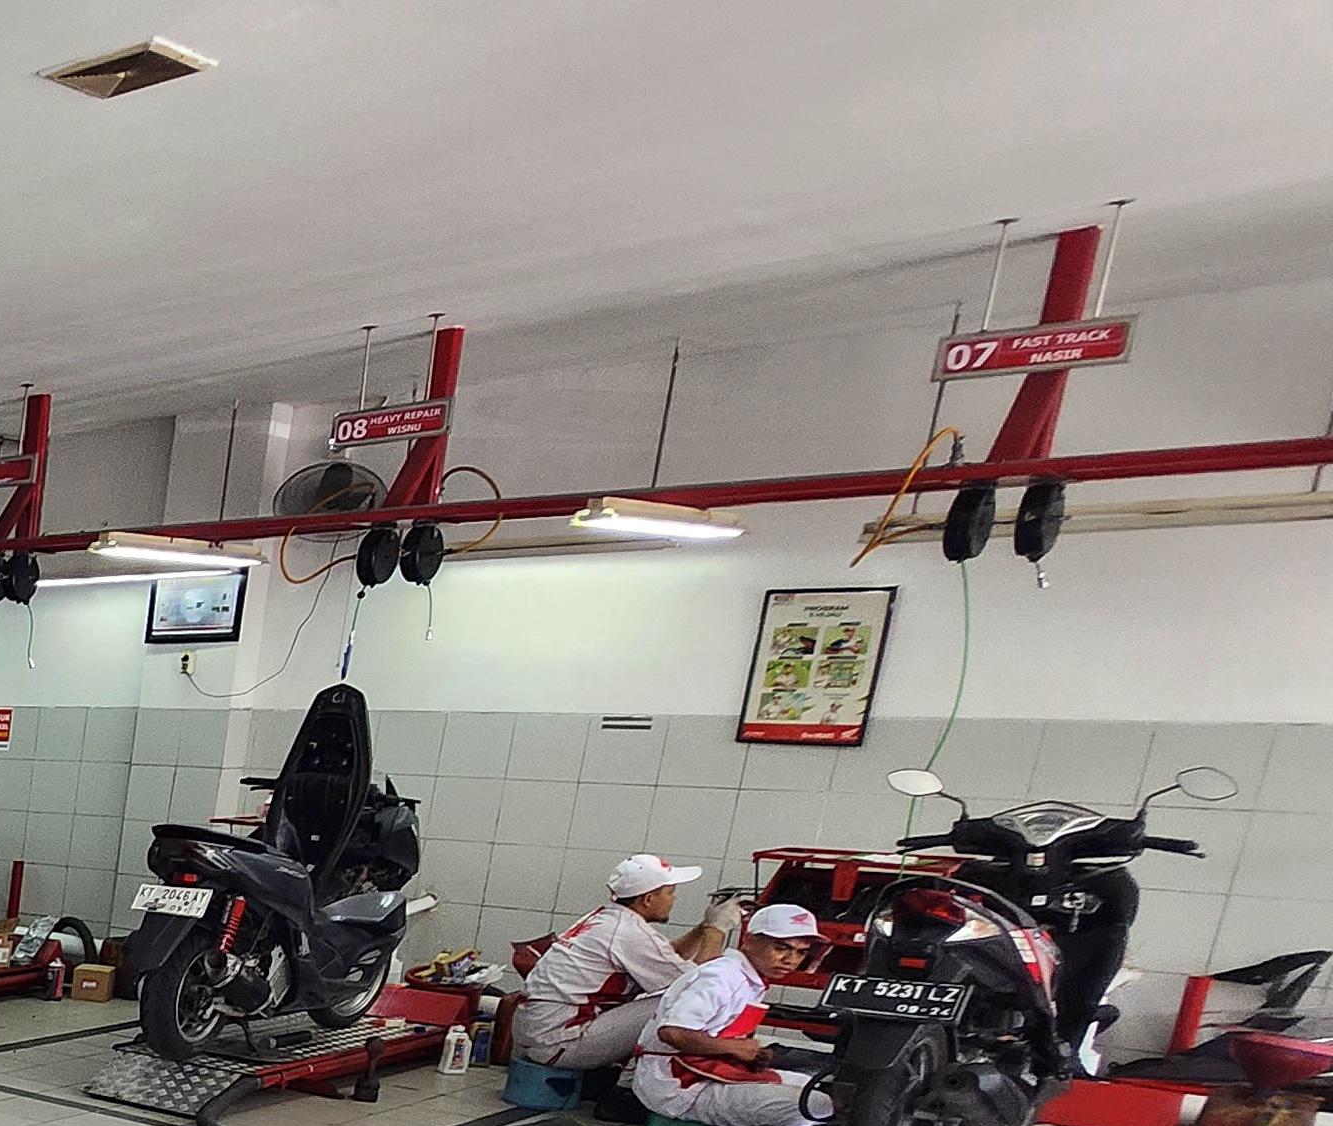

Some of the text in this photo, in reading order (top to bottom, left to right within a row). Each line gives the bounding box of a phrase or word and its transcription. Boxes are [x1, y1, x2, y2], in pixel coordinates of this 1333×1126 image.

[945, 328, 1111, 371] 07 FAST TRACK
[1029, 348, 1084, 364] NASIR
[338, 407, 442, 441] 08 HEAVY REPAIR
[387, 423, 422, 436] WISNU
[139, 887, 207, 903] KT 2046 AY
[834, 977, 960, 1003] KT 5231 LZ
